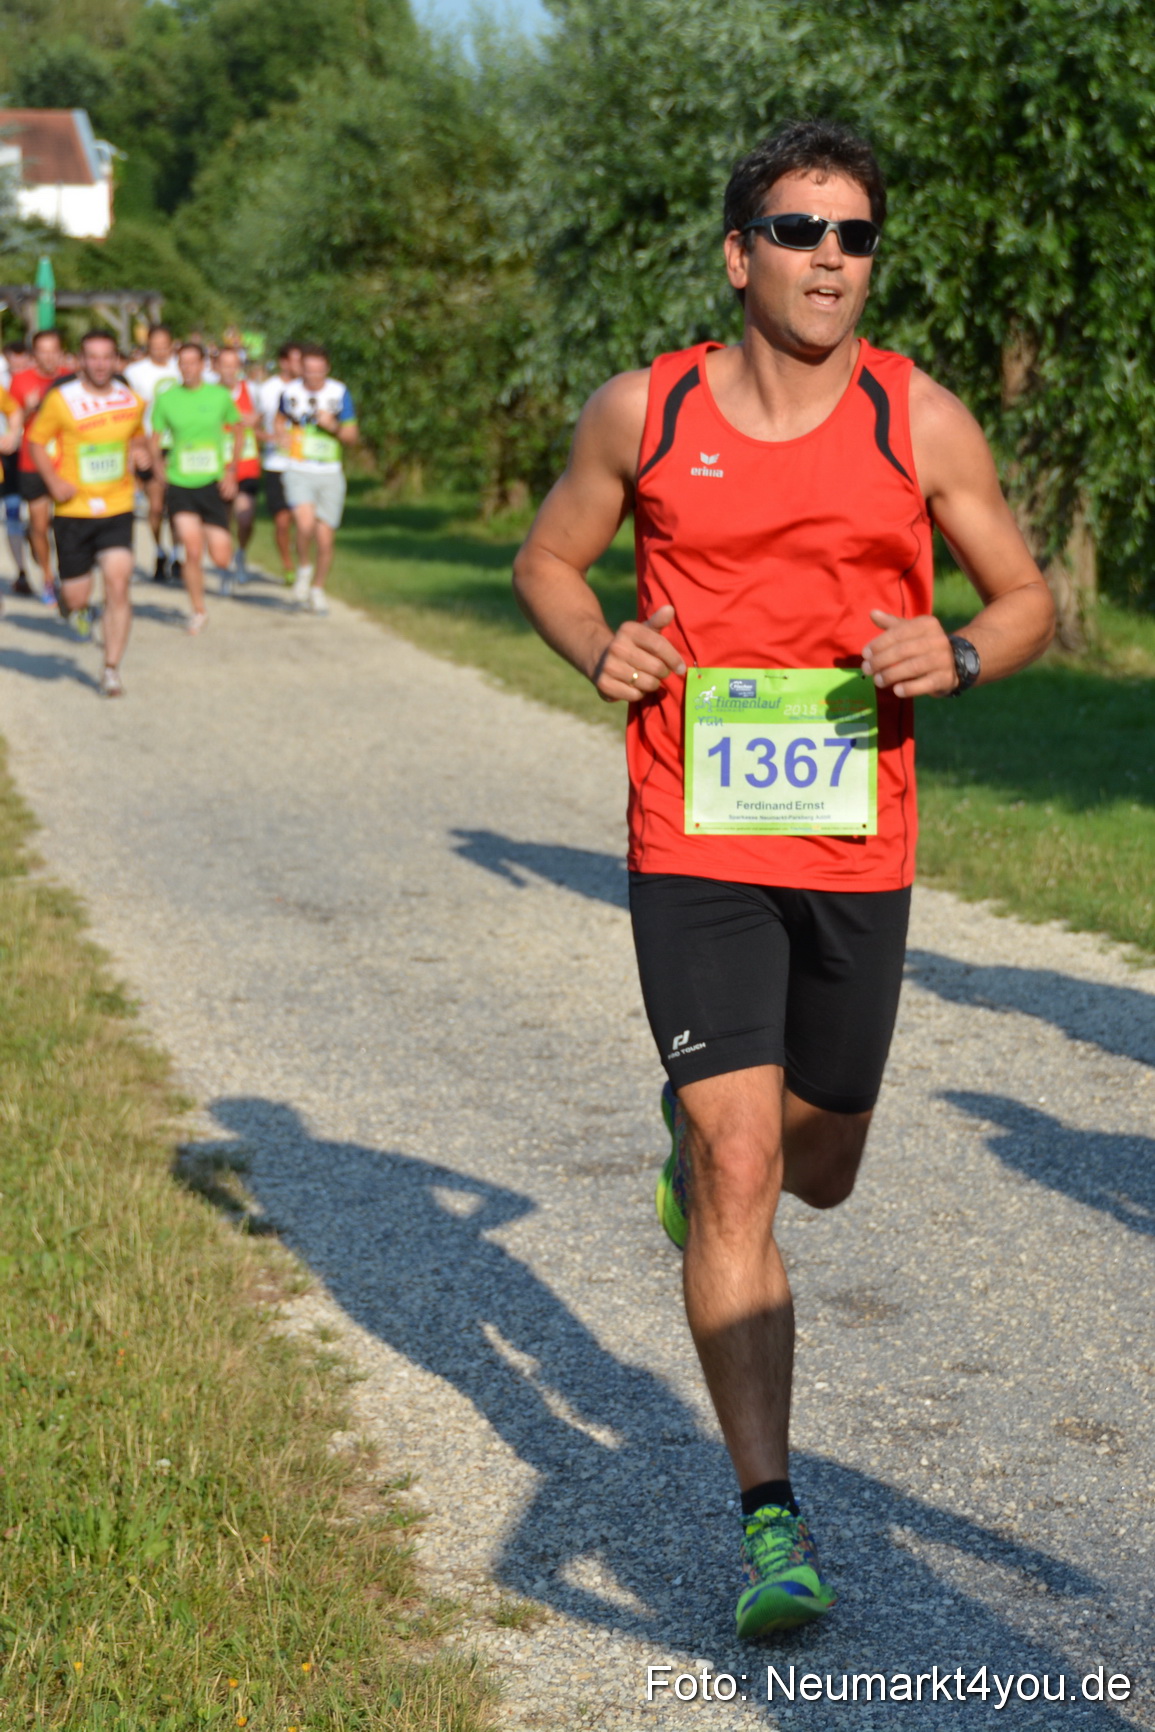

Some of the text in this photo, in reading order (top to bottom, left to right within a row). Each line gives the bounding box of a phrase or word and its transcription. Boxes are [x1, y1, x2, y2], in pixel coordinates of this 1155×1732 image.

[716, 696, 782, 710] firmenlauf
[783, 704, 818, 716] 2015
[707, 736, 857, 789] 1367
[736, 800, 825, 811] Ferdinand Ernst
[680, 1041, 707, 1055] TOUCH
